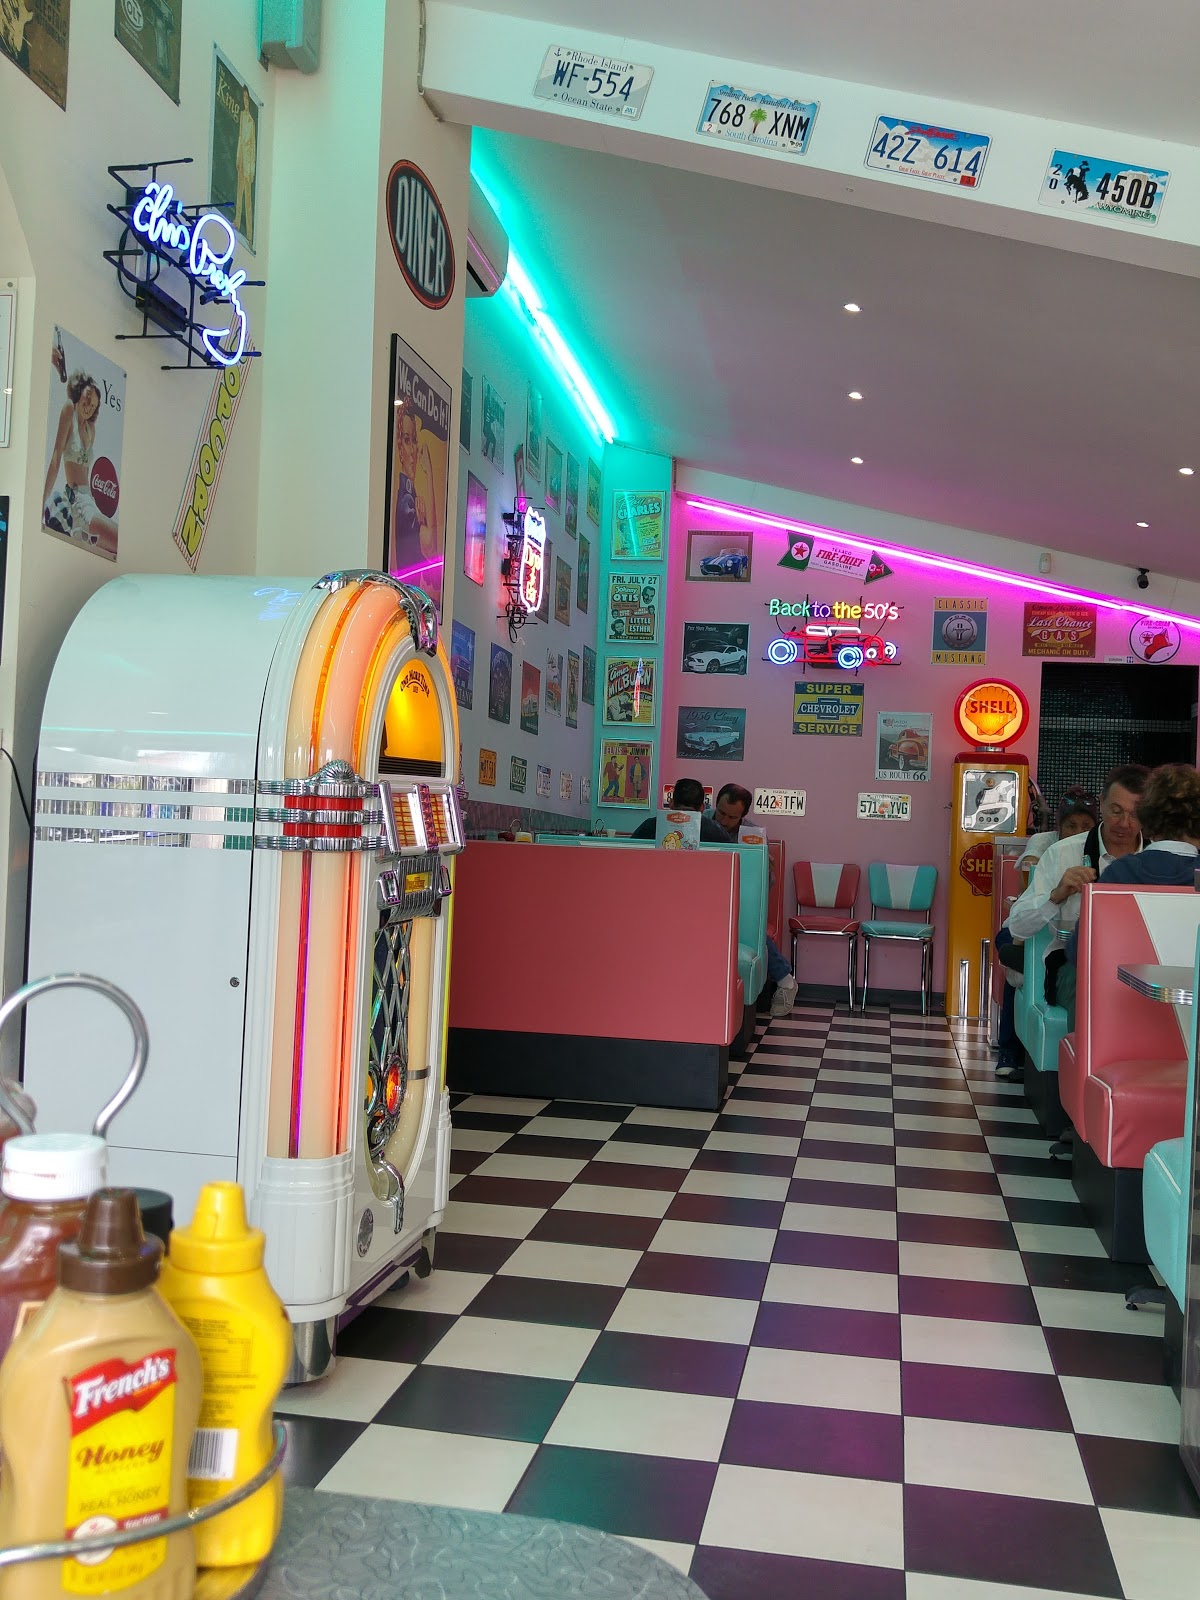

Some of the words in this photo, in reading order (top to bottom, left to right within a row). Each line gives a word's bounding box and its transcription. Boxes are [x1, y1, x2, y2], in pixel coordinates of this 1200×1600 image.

[571, 51, 599, 66] Rhode
[600, 58, 629, 72] Island
[552, 59, 635, 101] WF-554
[217, 76, 240, 123] King
[561, 91, 588, 107] Ocean
[590, 99, 613, 112] State
[707, 97, 746, 128] 768
[767, 110, 811, 141] XNM
[725, 129, 748, 142] South
[747, 133, 778, 147] Carolina
[872, 132, 922, 165] 42Z
[933, 144, 982, 177] 614
[1096, 172, 1158, 209] 450B
[1096, 202, 1153, 220] WYOMING
[395, 175, 446, 296] DINER
[102, 378, 122, 412] Yes
[399, 360, 412, 396] We
[412, 374, 427, 413] Can
[427, 388, 439, 422] Do
[439, 399, 449, 431] It!
[617, 502, 661, 520] CHARLES
[816, 549, 865, 568] FIRE-CHIEF
[823, 560, 852, 571] GASOLINE
[612, 575, 626, 584] FRI.
[627, 576, 646, 584] JULY
[613, 593, 639, 602] OTIS
[615, 586, 638, 594] Johnny
[769, 598, 810, 618] Back
[812, 600, 831, 618] to
[832, 600, 862, 619] the
[864, 602, 899, 620] 50's
[938, 599, 984, 610] CLASSIC
[629, 617, 652, 625] LITTLE
[1027, 617, 1053, 627] Last
[1055, 616, 1093, 628] Chance
[629, 625, 651, 633] ESTHER
[1041, 630, 1077, 641] GAS
[935, 653, 982, 663] MUSTANG
[806, 683, 852, 695] SUPER
[800, 703, 857, 715] CHEVROLET
[969, 700, 1013, 714] SHELL
[685, 710, 711, 721] 1956
[713, 710, 739, 725] Chevy
[798, 723, 857, 735] SERVICE
[606, 745, 623, 755] ELVIS
[878, 771, 887, 779] US
[889, 771, 911, 780] ROUTE
[913, 770, 927, 781] 66
[756, 794, 776, 809] 442
[784, 795, 804, 810] TFW
[860, 800, 878, 814] 571
[890, 801, 908, 815] YVG
[966, 858, 994, 873] SHE
[73, 1356, 170, 1418] French's
[76, 1439, 165, 1469] Honey
